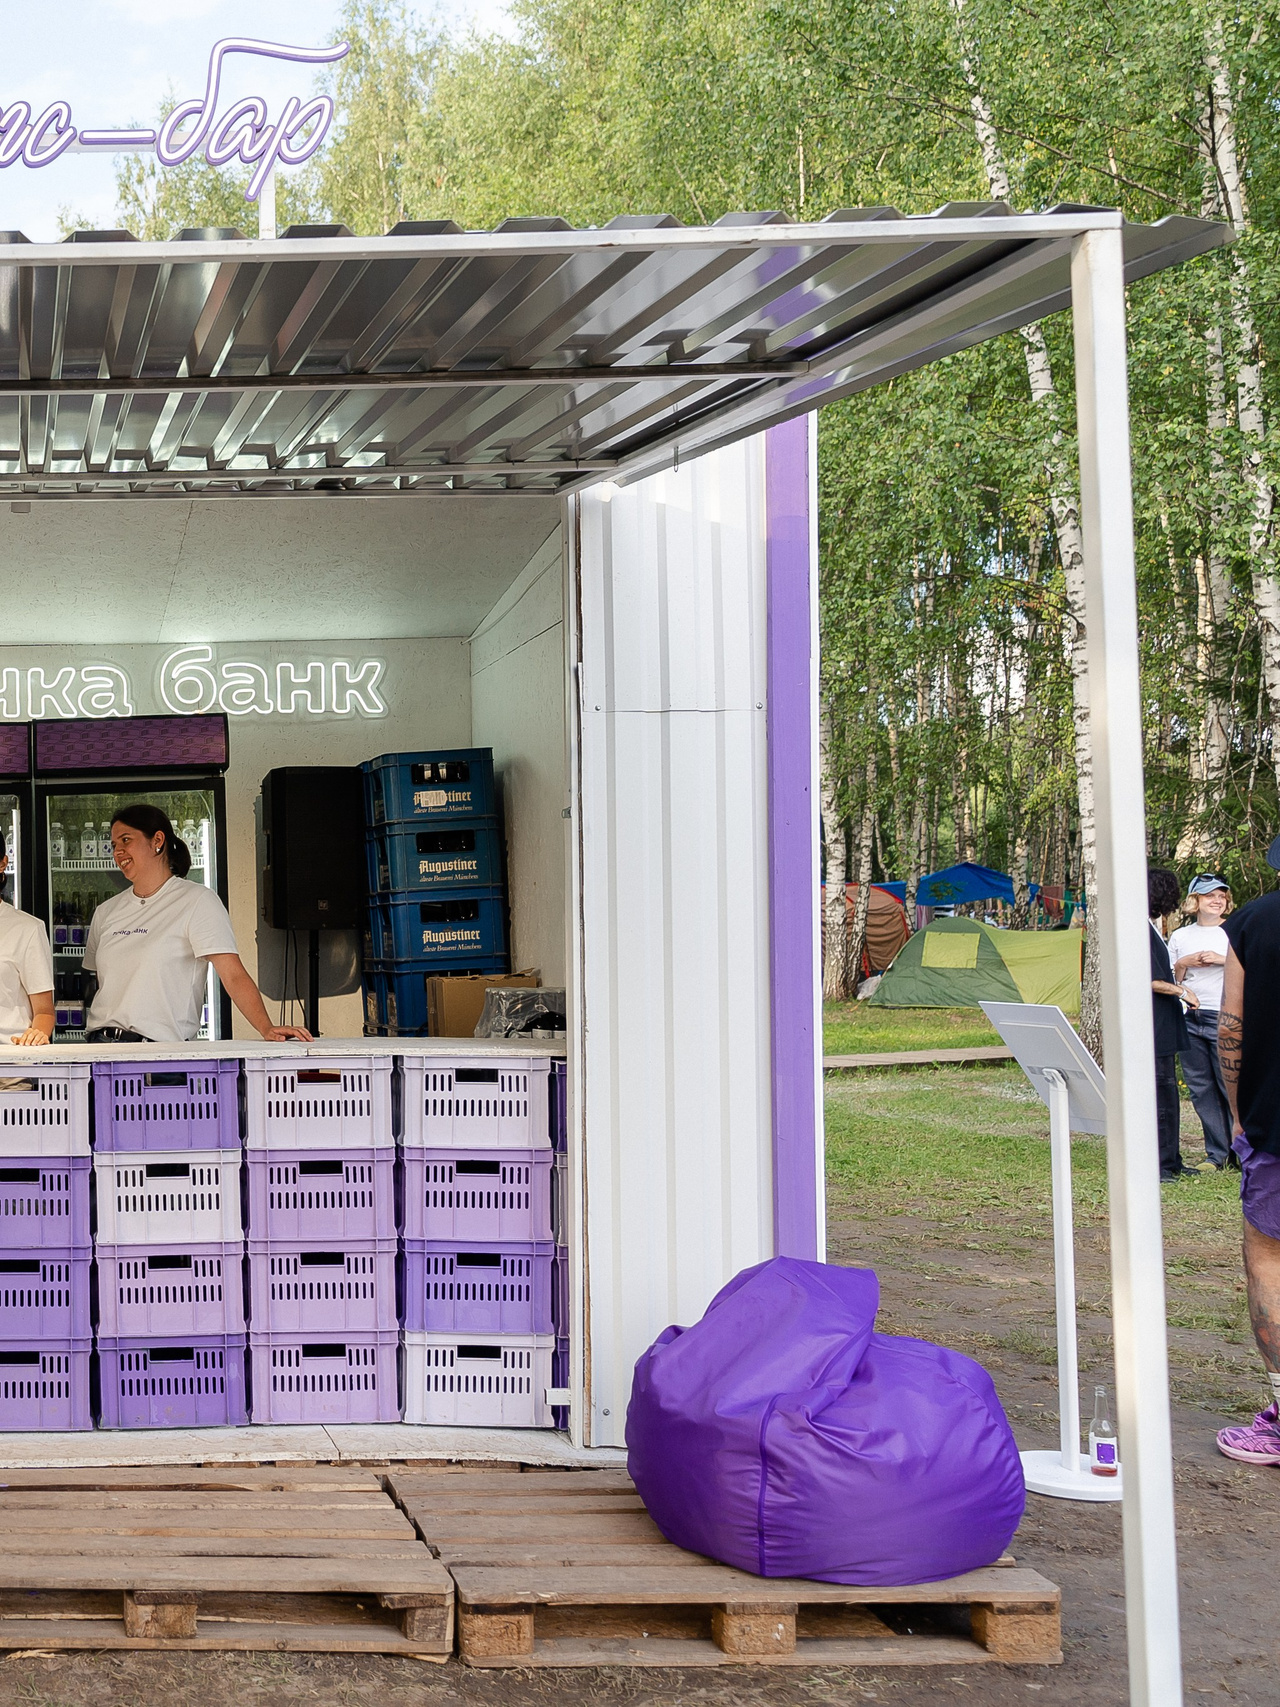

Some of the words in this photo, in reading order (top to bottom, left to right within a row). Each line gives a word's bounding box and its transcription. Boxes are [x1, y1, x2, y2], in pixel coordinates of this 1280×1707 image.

[160, 645, 385, 716] банк
[419, 858, 477, 874] Augustiner
[422, 929, 480, 944] Augustiner
